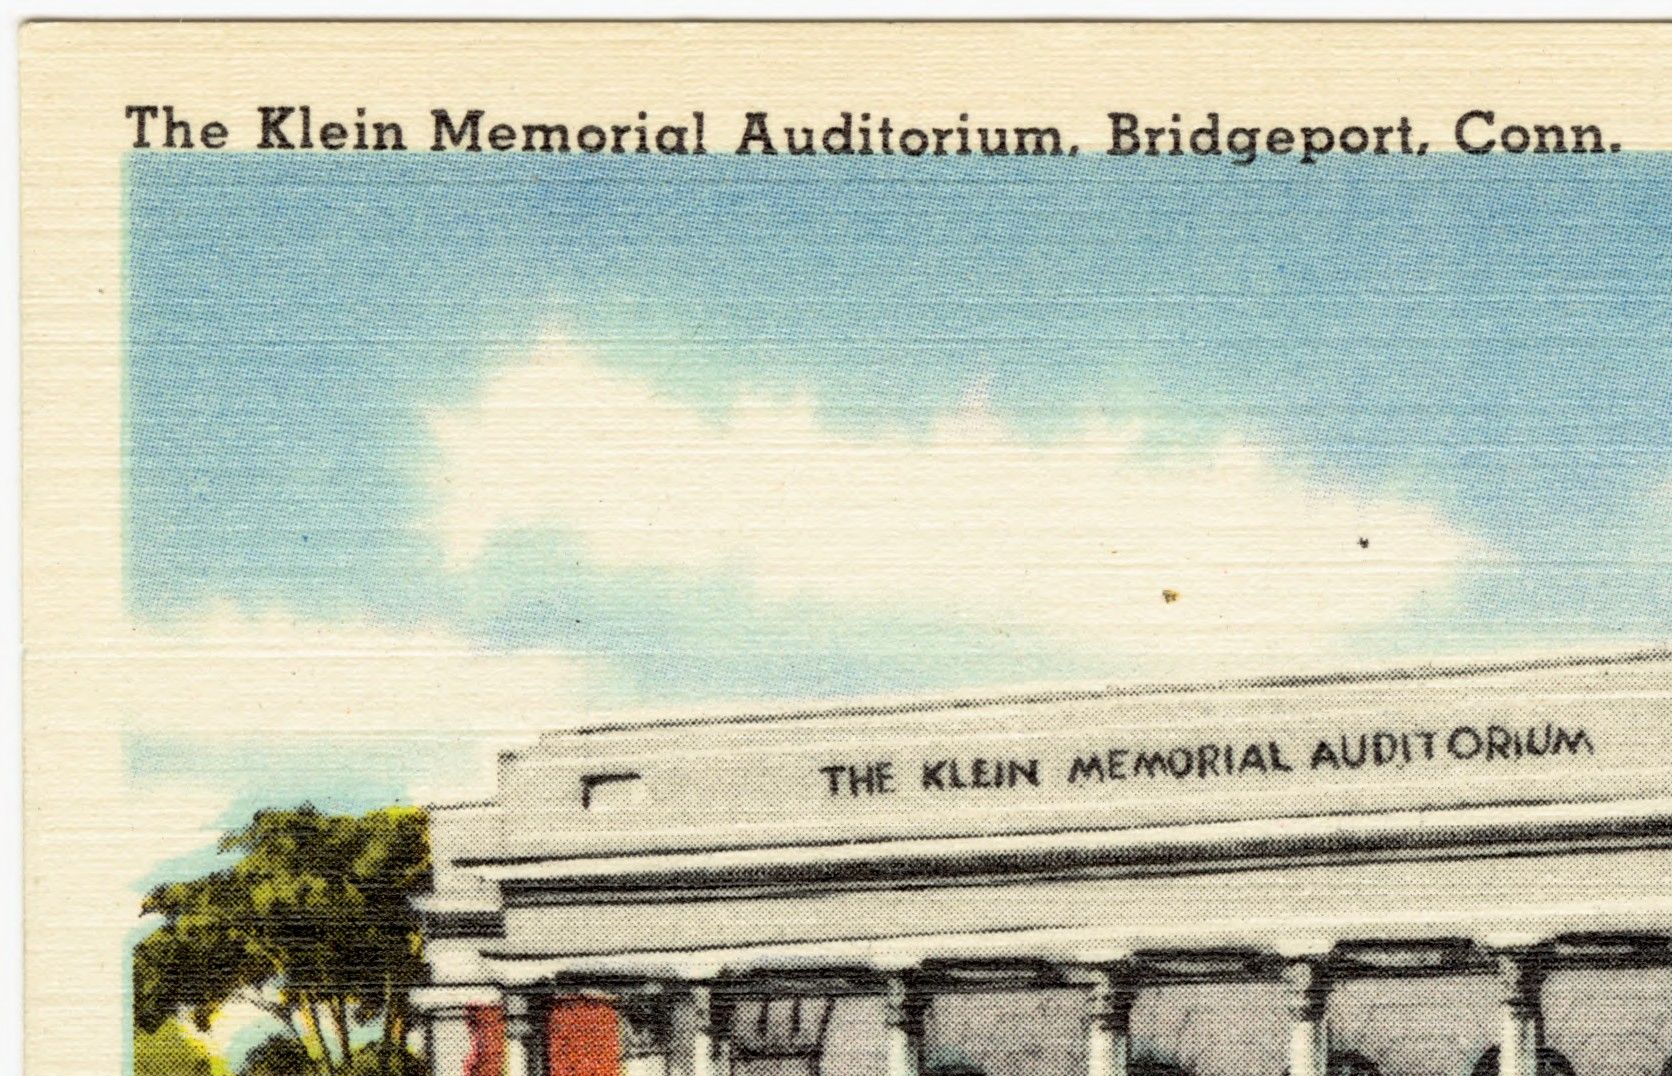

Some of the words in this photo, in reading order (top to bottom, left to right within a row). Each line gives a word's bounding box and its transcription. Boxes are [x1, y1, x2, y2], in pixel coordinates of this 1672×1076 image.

[124, 104, 229, 149] The
[255, 105, 408, 151] Klein
[429, 108, 707, 156] Memorial
[734, 111, 1080, 158] Auditorium,
[1106, 111, 1430, 164] Bridgeport,
[1454, 109, 1622, 154] Conn.
[819, 763, 896, 798] THE
[920, 755, 1042, 791] KLEIN
[1067, 741, 1294, 785] MEMORIAL
[1309, 722, 1596, 772] AUDITORIUM
